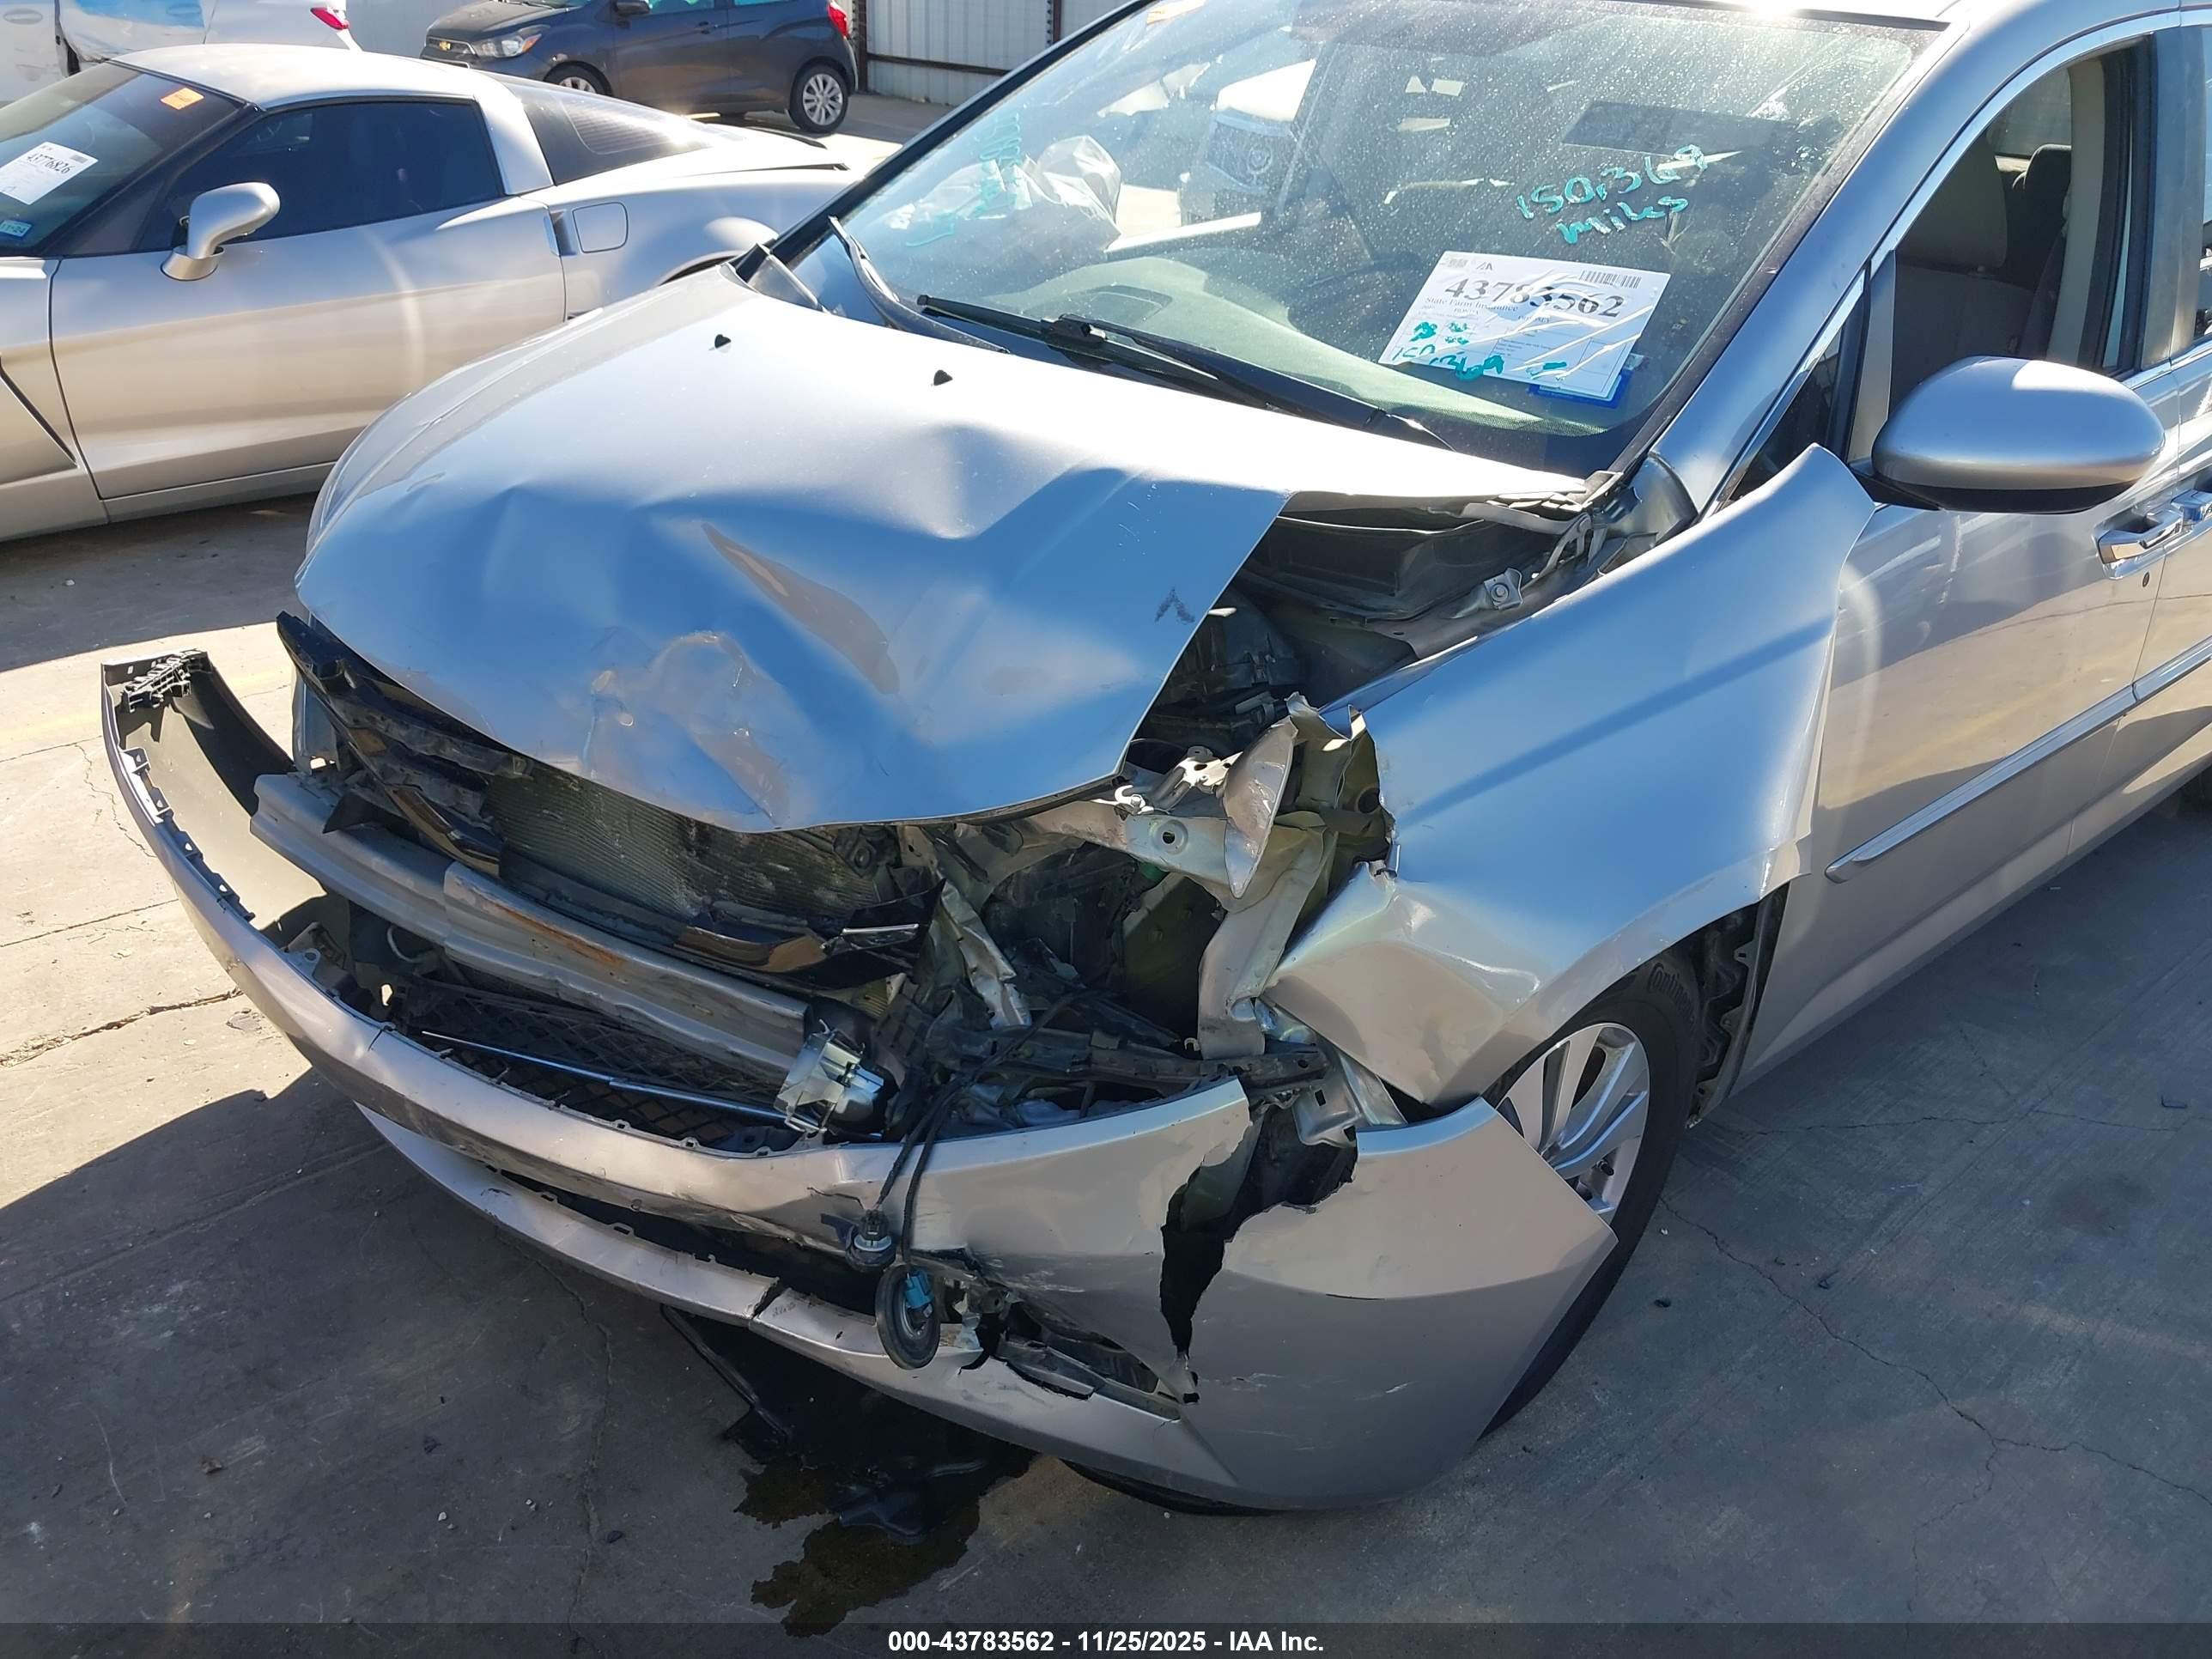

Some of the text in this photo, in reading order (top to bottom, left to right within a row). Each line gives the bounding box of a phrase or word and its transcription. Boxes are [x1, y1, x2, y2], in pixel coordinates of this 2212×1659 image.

[1425, 296, 1448, 306] State
[1449, 299, 1474, 308] Farm
[1444, 278, 1625, 318] 43783562
